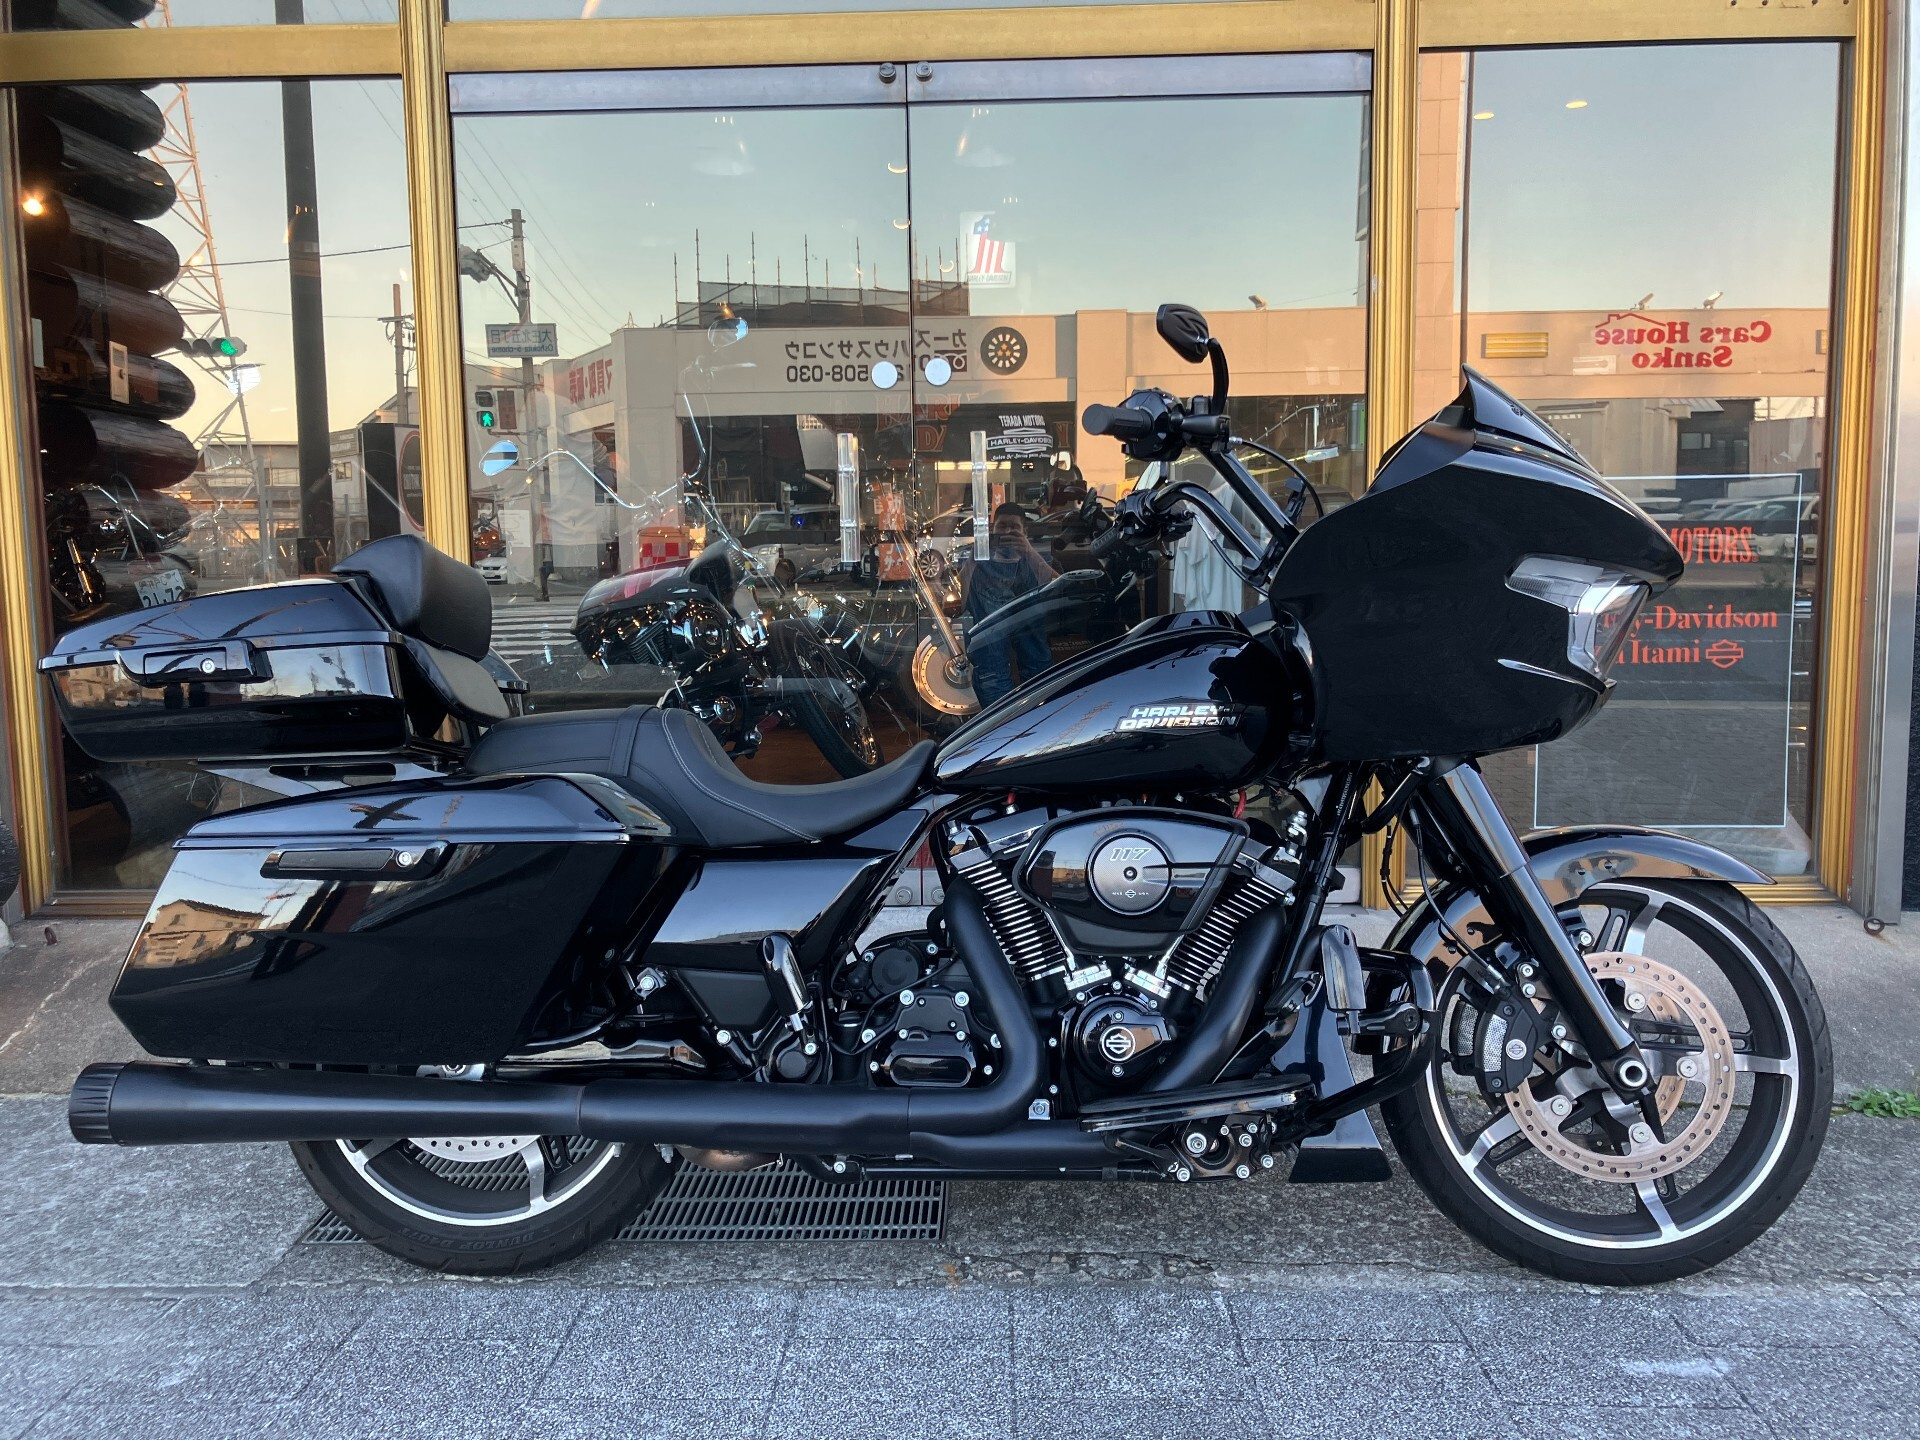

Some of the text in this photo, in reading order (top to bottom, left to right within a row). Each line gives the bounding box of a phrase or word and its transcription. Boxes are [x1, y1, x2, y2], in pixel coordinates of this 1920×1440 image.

[1630, 639, 1700, 664] Itami
[1120, 716, 1236, 730] DAVIDSON
[1110, 847, 1152, 861] 117
[458, 1231, 535, 1250] DUNLOP
